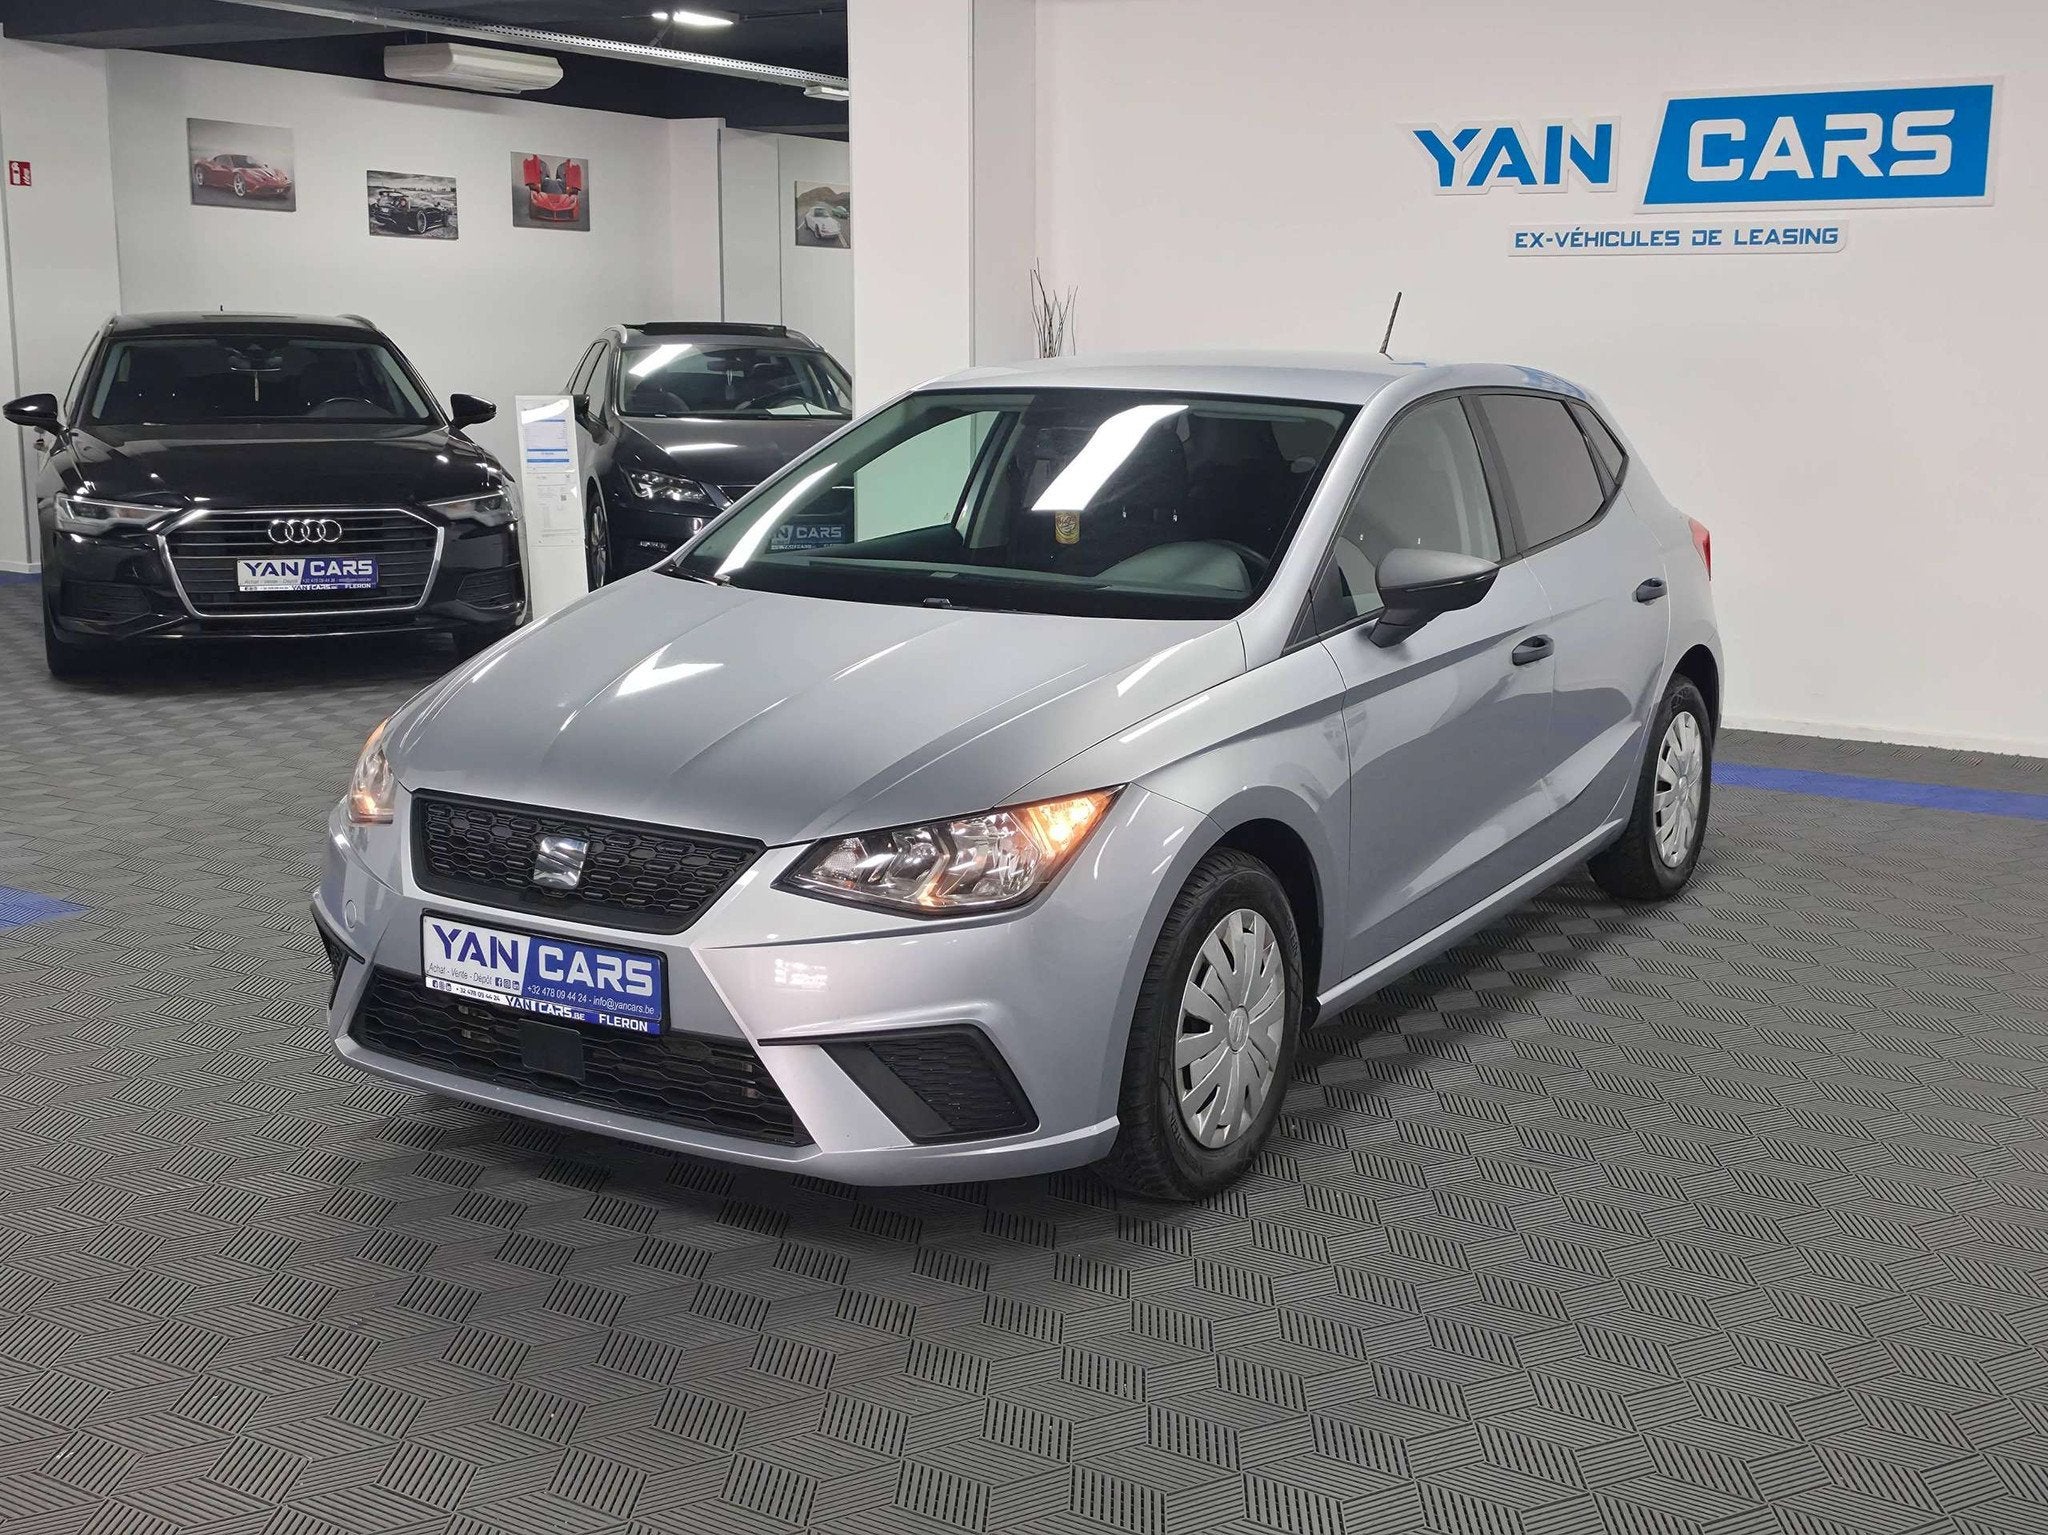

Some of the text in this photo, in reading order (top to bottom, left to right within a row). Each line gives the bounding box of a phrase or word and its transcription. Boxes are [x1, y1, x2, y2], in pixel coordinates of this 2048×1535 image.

[1412, 109, 1956, 187] YAN CARS
[1515, 227, 1839, 248] EX-VÉHICULES DE LEASING
[796, 527, 842, 538] CARS
[244, 560, 373, 577] YAN CARS
[428, 963, 446, 975] Achat
[451, 968, 468, 980] Vente
[432, 924, 653, 997] YAN CARS
[527, 984, 540, 995] +32
[542, 987, 554, 997] 478
[556, 989, 566, 999] 09
[567, 991, 576, 1001] 44
[578, 993, 587, 1003] 24
[593, 996, 655, 1015] info@yancars.be
[505, 995, 532, 1012] YAN
[599, 1013, 649, 1032] FLERON
